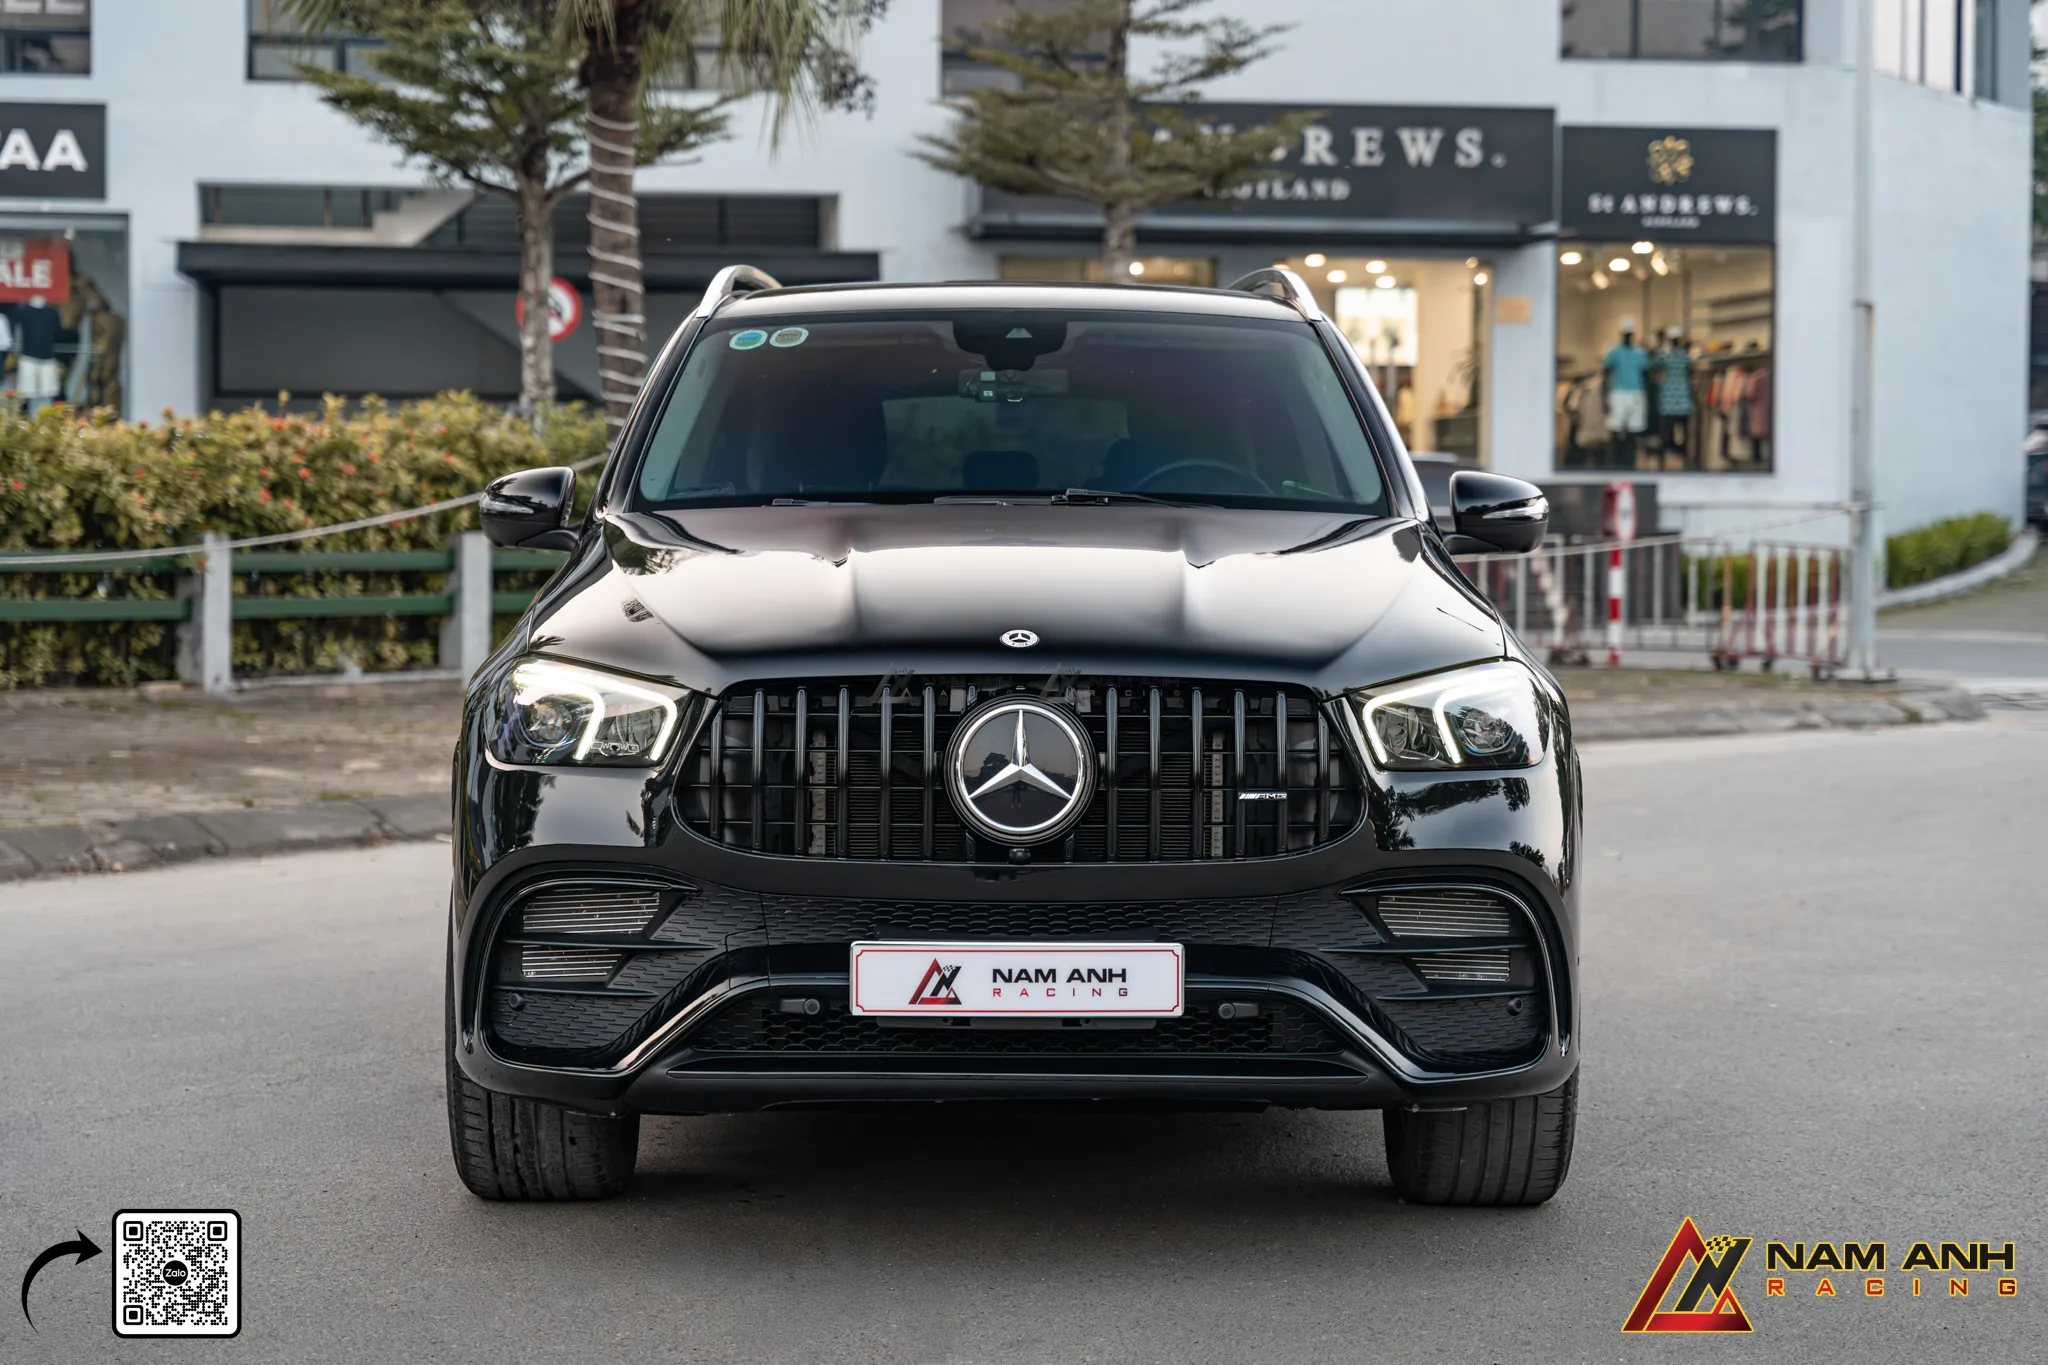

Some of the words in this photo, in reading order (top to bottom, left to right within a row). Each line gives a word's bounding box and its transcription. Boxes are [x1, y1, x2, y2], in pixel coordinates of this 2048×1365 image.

[0, 128, 89, 172] AA
[992, 968, 1057, 984] NAM
[1066, 968, 1127, 984] ANH
[993, 987, 1128, 998] RACING
